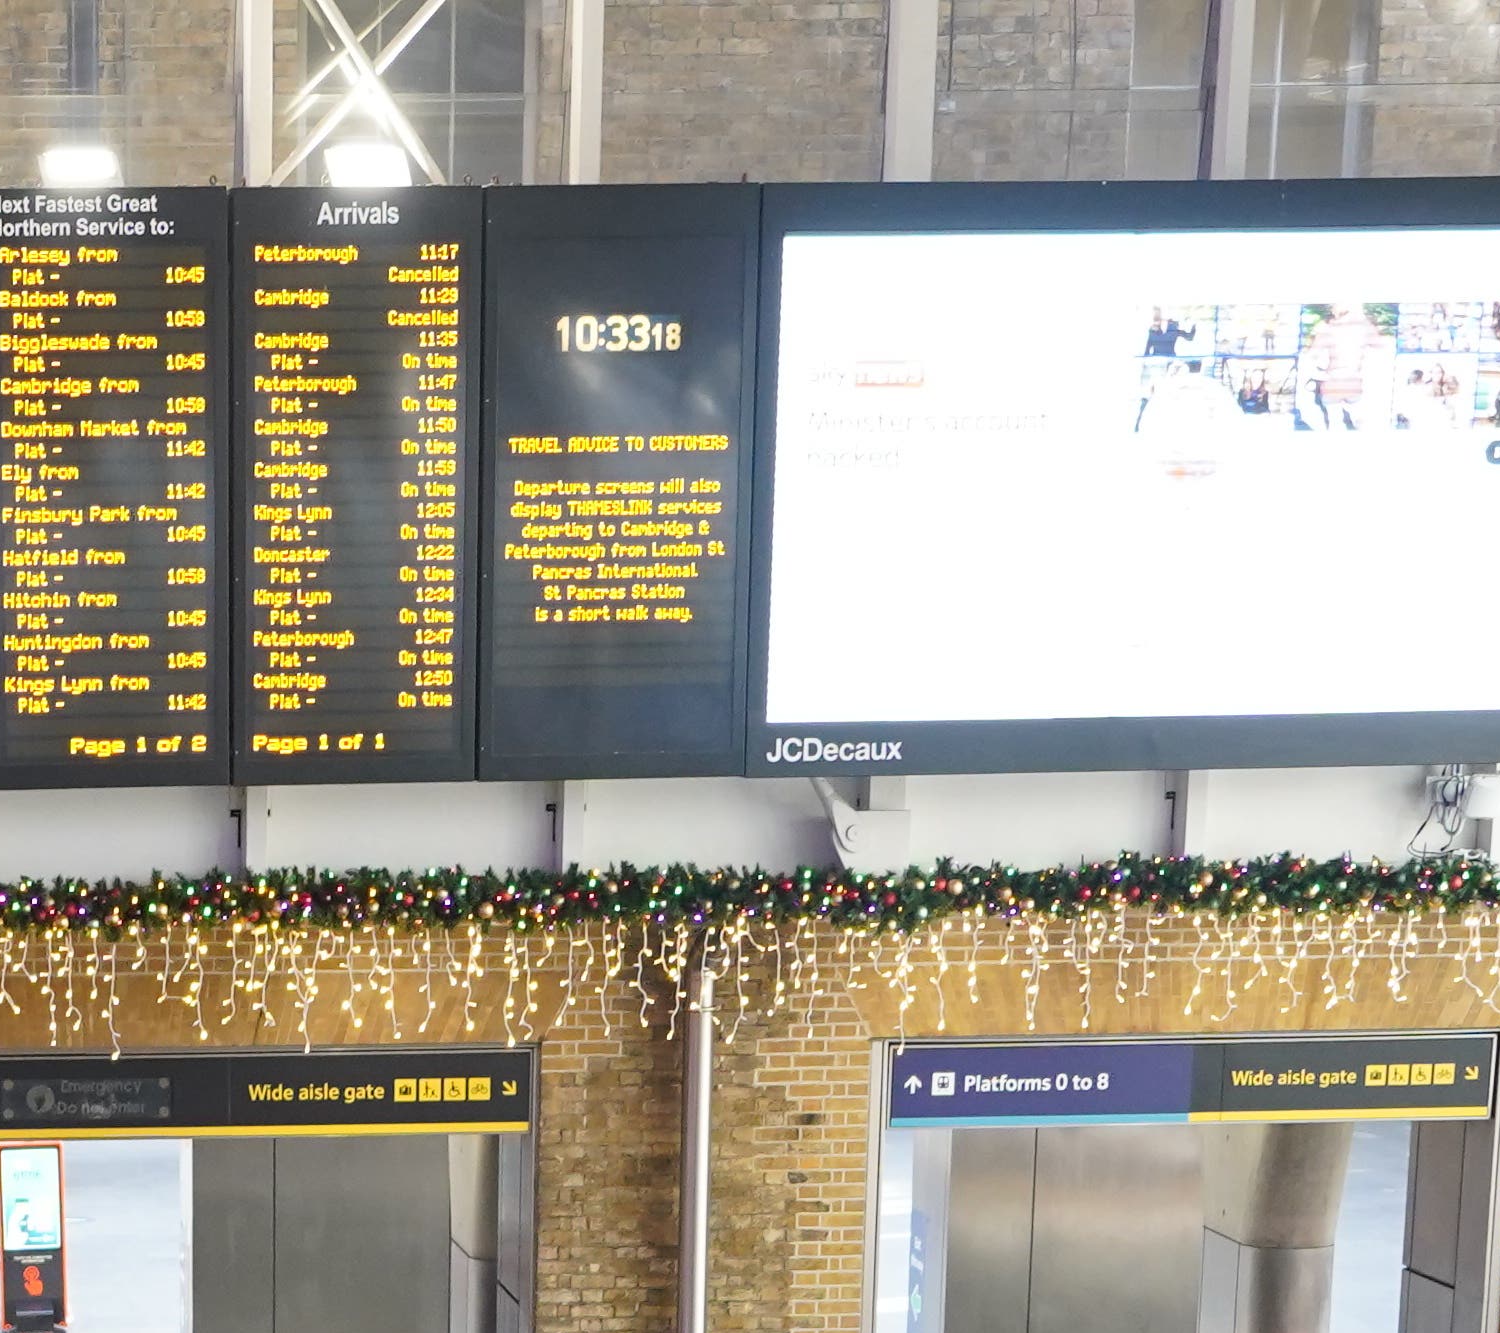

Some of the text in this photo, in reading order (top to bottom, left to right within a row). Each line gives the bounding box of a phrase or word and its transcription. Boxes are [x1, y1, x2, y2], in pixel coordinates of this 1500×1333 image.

[35, 192, 105, 212] Fastest
[107, 194, 157, 212] Great
[317, 196, 399, 225] Arrivals
[76, 218, 145, 235] Service
[150, 218, 174, 234] to:
[0, 247, 119, 265] Arlesey from
[256, 244, 459, 263] Peterborough 11:17
[389, 266, 460, 284] Cancelled
[557, 315, 682, 353] 10:33 18
[1, 333, 158, 355] Biggleswade from
[509, 435, 729, 453] TRAVEL ADVICE TO CUSTOMERS
[514, 478, 721, 498] Departure screens will also
[510, 499, 722, 520] display THAMESLINK services
[522, 520, 710, 541] departing to Cambridge &
[505, 541, 725, 561] Peterborough from London St
[533, 563, 698, 580] Pancras International.
[544, 584, 685, 600] St Pancras Station
[535, 605, 693, 623] is a short walk away.
[766, 737, 902, 762] JCDecaux
[965, 1073, 1108, 1092] Platforms 0 to 8
[1232, 1071, 1356, 1086] Wide aisle gate
[249, 1084, 384, 1103] Wide aisle gate
